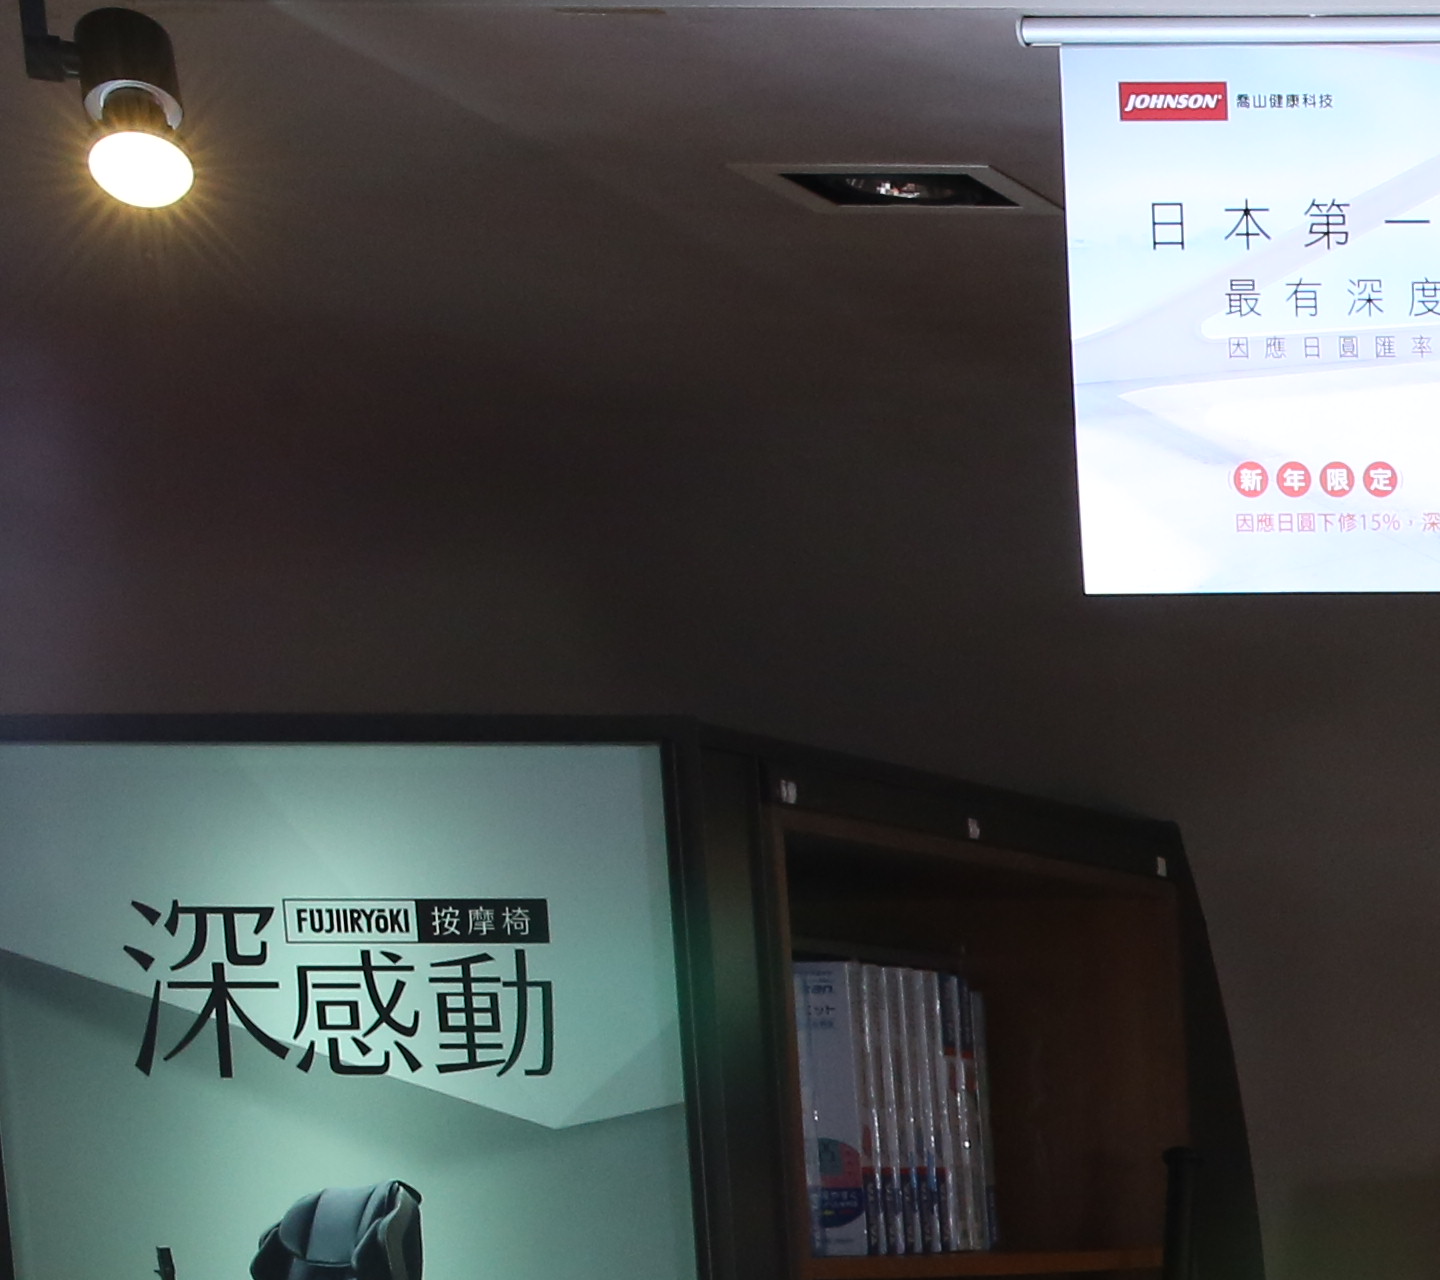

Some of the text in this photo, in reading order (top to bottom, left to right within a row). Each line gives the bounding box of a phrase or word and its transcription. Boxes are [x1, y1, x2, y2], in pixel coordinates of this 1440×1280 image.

[1124, 93, 1220, 112] JOHNSON
[1236, 93, 1334, 109] 喬山健康科技
[1151, 198, 1431, 250] 日本第一
[1238, 464, 1395, 494] 新年限定
[432, 905, 531, 936] 按摩椅
[123, 899, 554, 1078] 深感動
